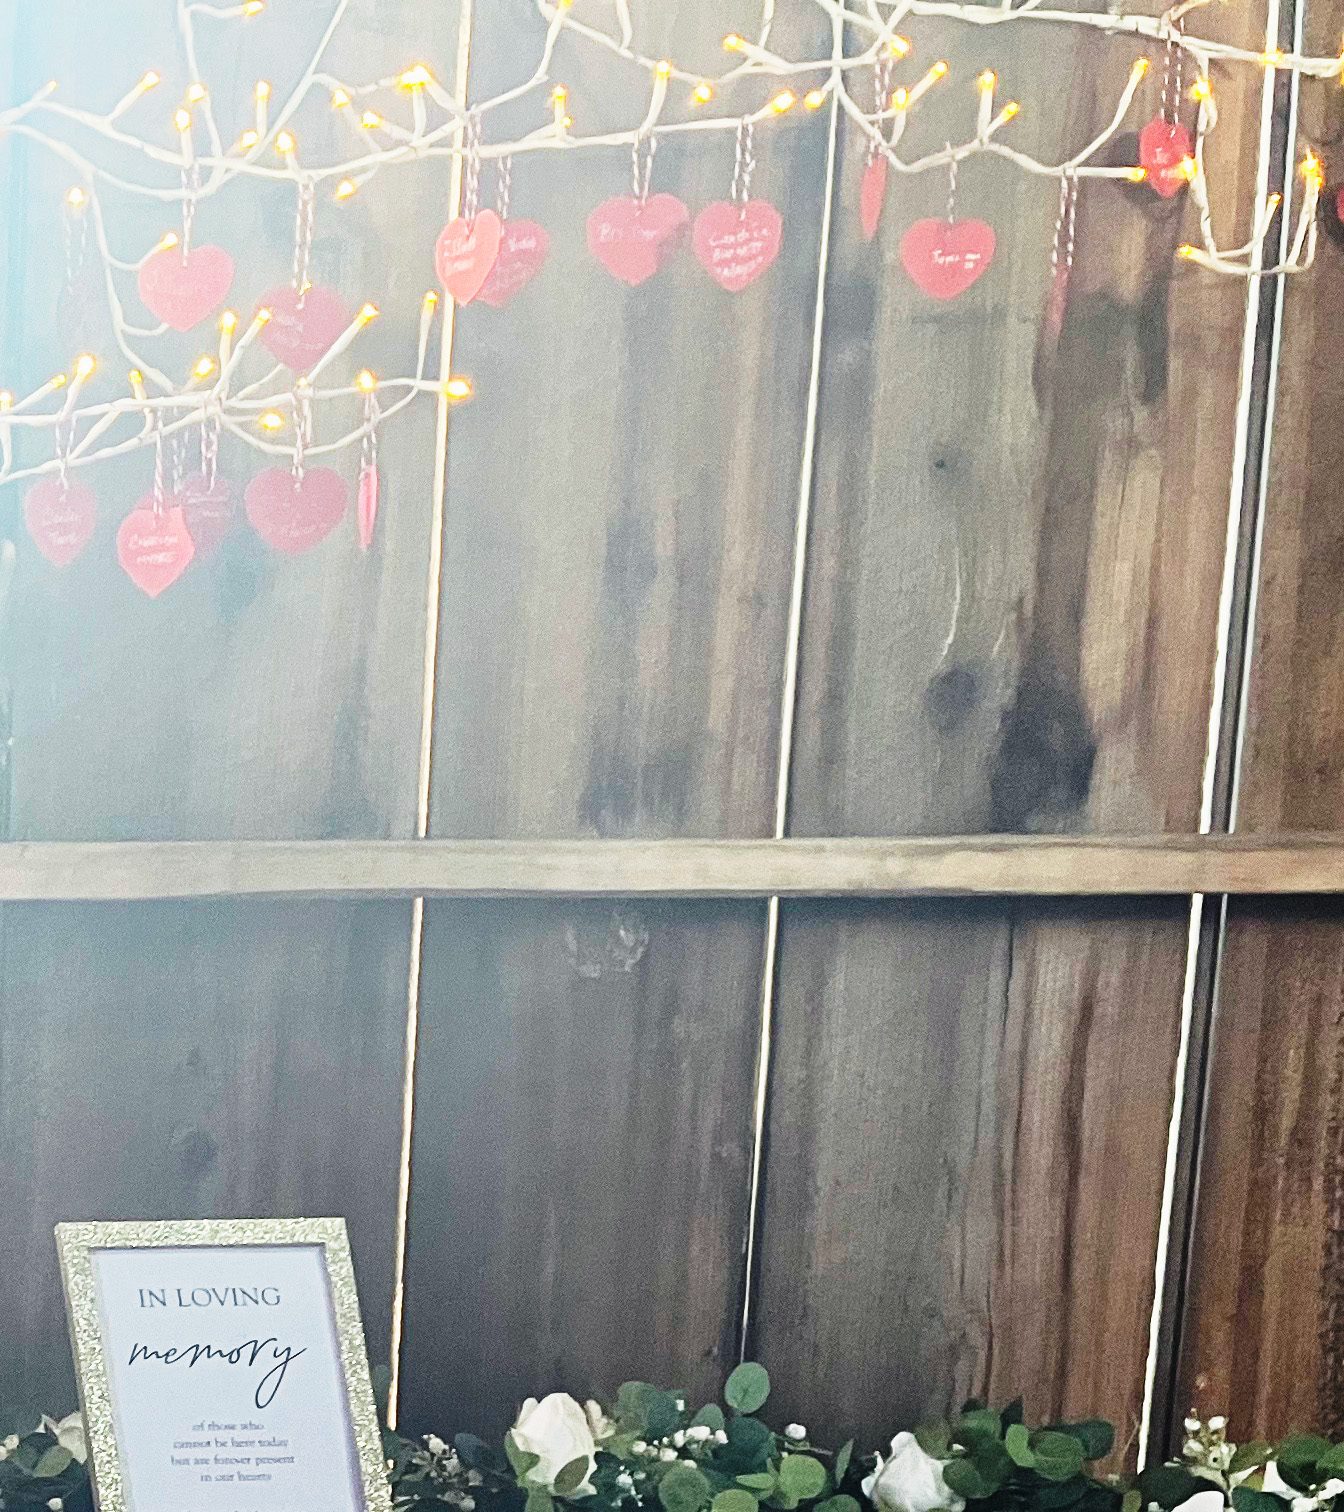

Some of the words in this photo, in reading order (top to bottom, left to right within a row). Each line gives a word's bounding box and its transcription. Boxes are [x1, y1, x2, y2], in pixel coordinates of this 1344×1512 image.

[138, 1287, 168, 1308] IN
[176, 1286, 282, 1308] LOVING
[127, 1336, 309, 1410] memory
[192, 1420, 206, 1432] of
[208, 1421, 237, 1431] those
[240, 1420, 265, 1431] who
[173, 1440, 211, 1449] cannot
[215, 1437, 229, 1448] be
[231, 1436, 256, 1448] here
[257, 1436, 289, 1449] today
[170, 1454, 190, 1466] but
[193, 1457, 211, 1466] are
[213, 1454, 252, 1466] forever
[254, 1456, 295, 1467] present
[200, 1474, 213, 1482] in
[214, 1474, 235, 1482] our
[236, 1470, 273, 1482] hearts
